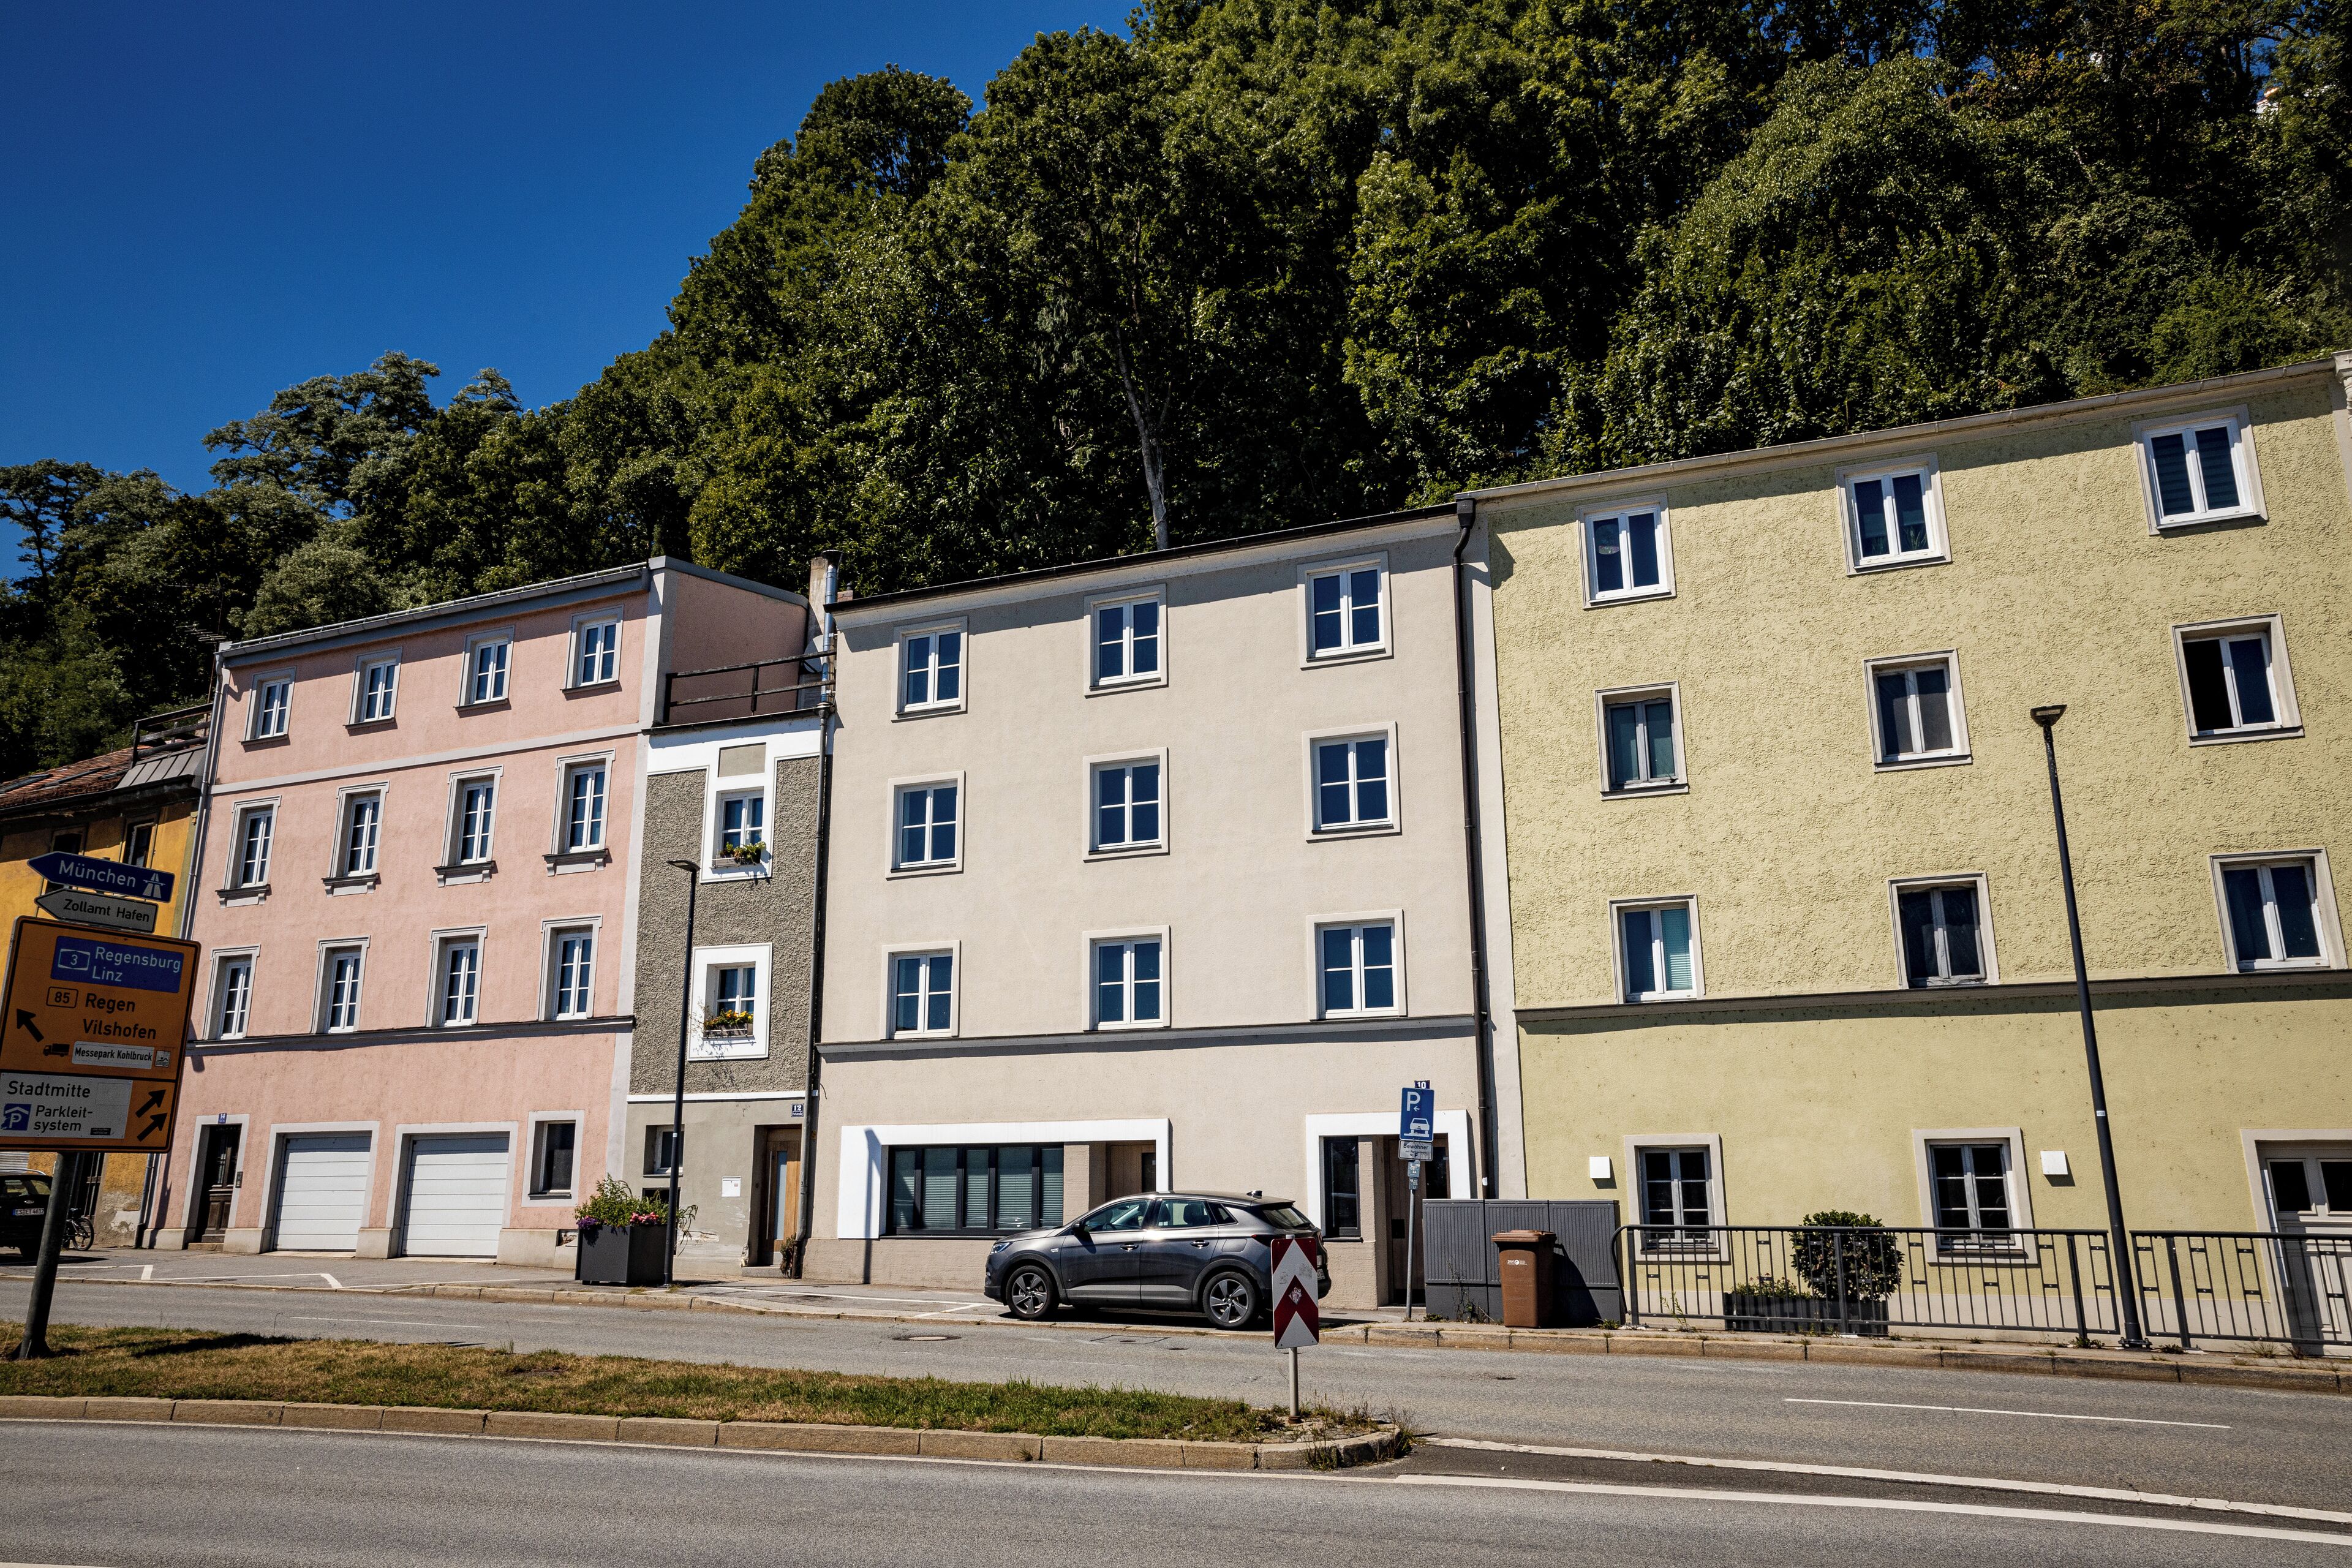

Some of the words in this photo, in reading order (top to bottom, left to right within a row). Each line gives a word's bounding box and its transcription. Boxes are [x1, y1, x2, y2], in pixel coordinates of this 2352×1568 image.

[59, 860, 136, 888] München
[63, 899, 111, 916] Zollamt
[116, 907, 149, 922] Hafen
[70, 954, 78, 965] 3
[95, 946, 181, 973] Regensburg
[92, 965, 123, 982] Linz
[55, 991, 70, 1004] 85
[85, 993, 136, 1014] Regen
[83, 1019, 157, 1039] Vilshofen
[75, 1047, 115, 1060] Messepark
[116, 1050, 152, 1061] Kohlbruck
[7, 1080, 91, 1098] Stadtmitte
[36, 1104, 93, 1118] Parkleit-
[1406, 1091, 1421, 1112] P
[34, 1120, 81, 1134] system
